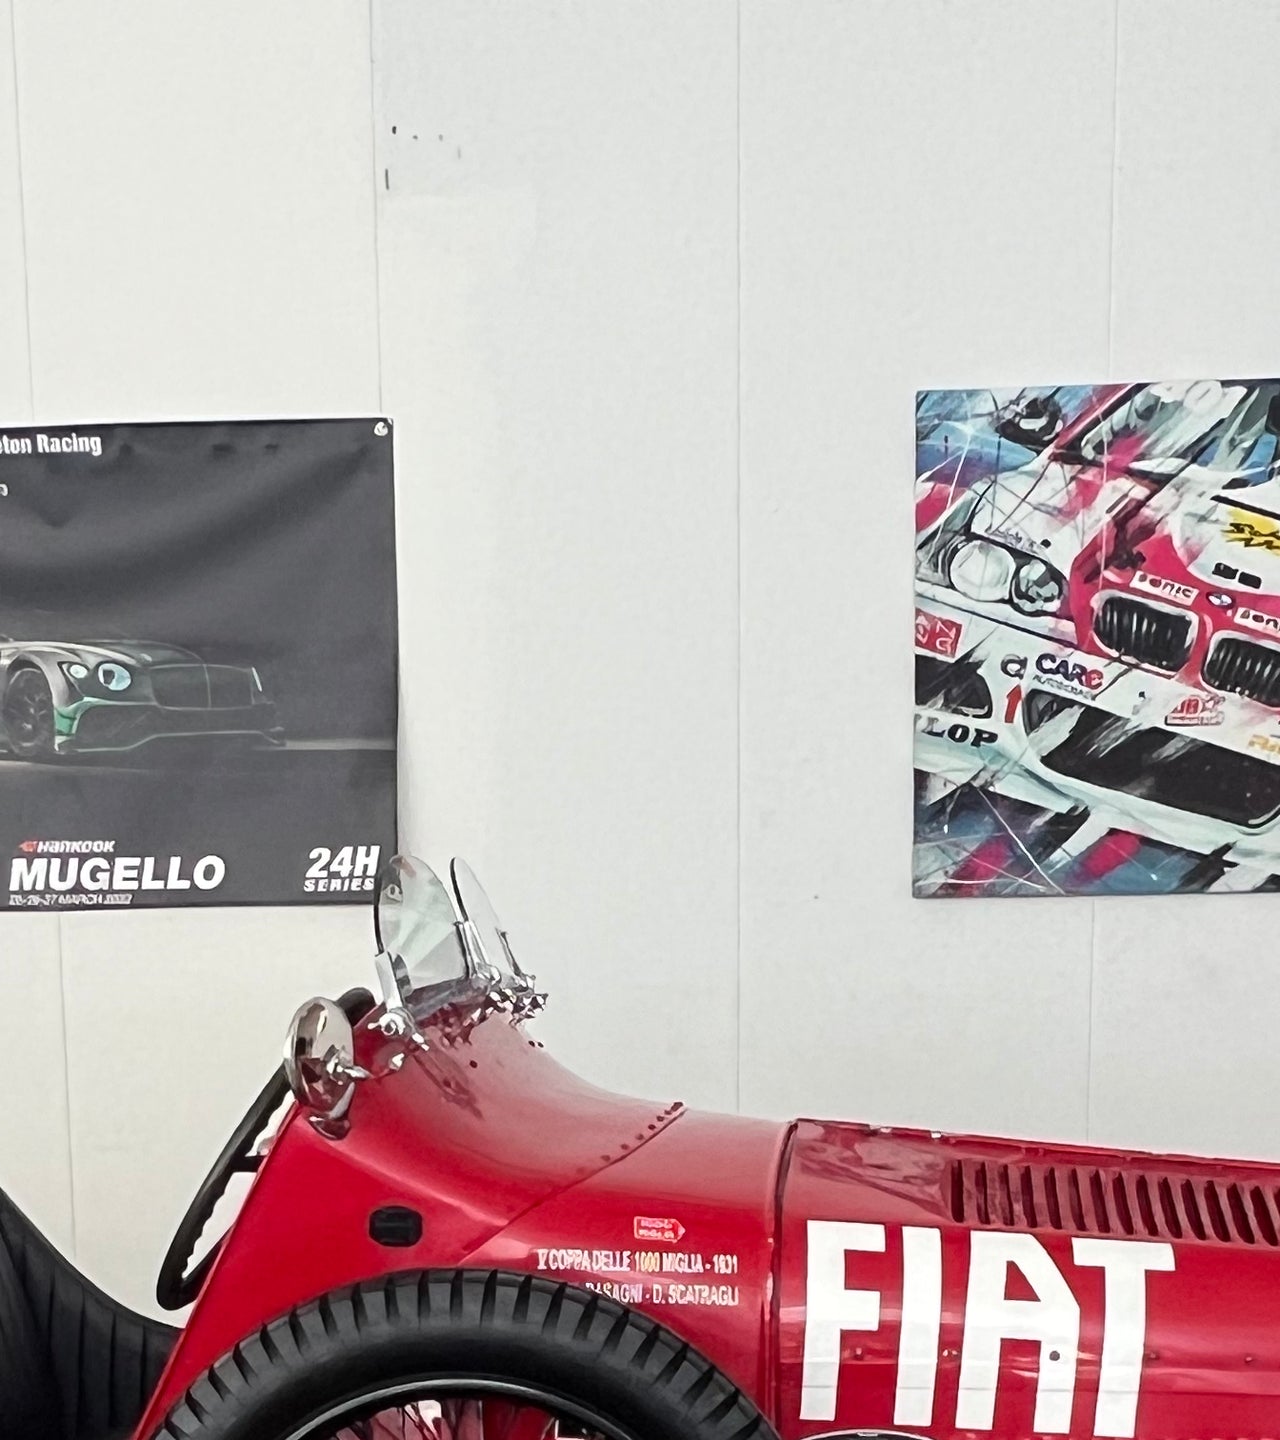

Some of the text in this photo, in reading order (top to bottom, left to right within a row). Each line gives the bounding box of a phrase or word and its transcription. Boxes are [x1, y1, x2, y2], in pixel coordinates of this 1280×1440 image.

[36, 432, 102, 456] Racing
[8, 855, 226, 891] MUGELLO
[305, 845, 381, 879] 24H
[303, 877, 376, 893] SERIES
[549, 1249, 593, 1271] COPPA
[592, 1249, 632, 1272] DELLE
[634, 1251, 661, 1273] 1000
[662, 1252, 704, 1274] MIGLIA
[712, 1254, 738, 1274] 1931
[798, 1218, 1176, 1440] FIAT
